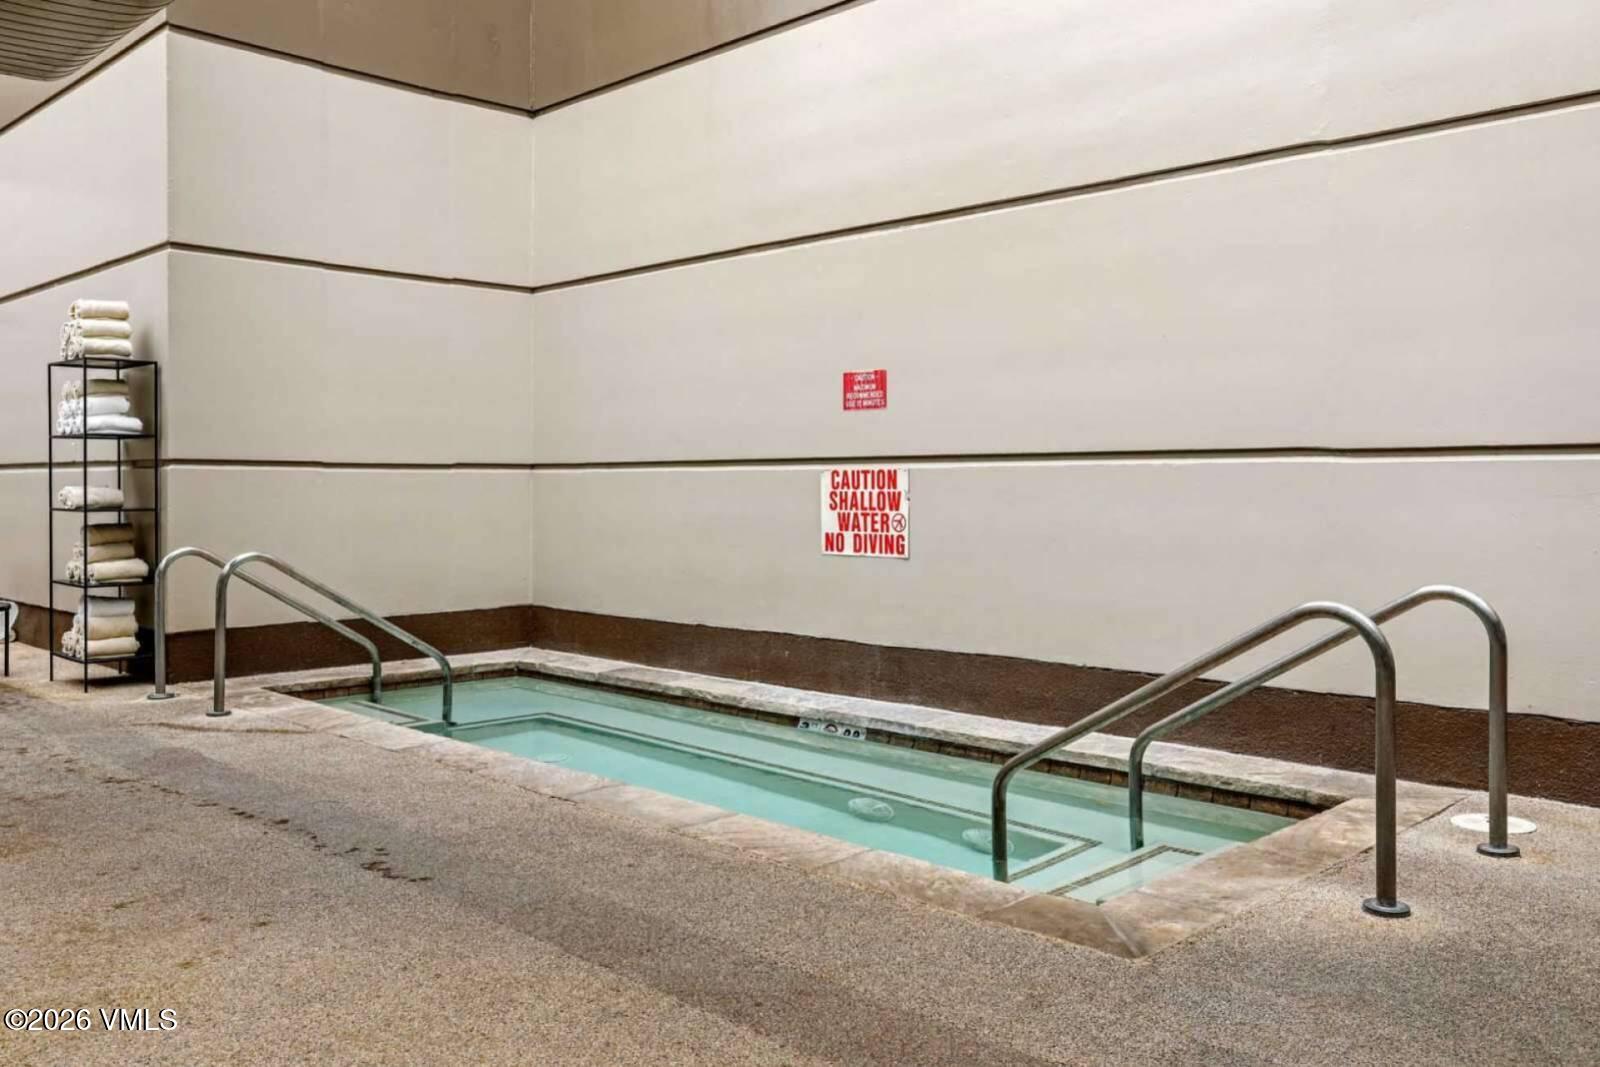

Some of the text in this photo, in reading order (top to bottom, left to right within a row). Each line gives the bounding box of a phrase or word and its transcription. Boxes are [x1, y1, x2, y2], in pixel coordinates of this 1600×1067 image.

[831, 469, 897, 490] CAUTION
[829, 491, 901, 511] SHALLOW
[837, 512, 889, 532] WATER
[825, 532, 905, 555] NO DIVING
